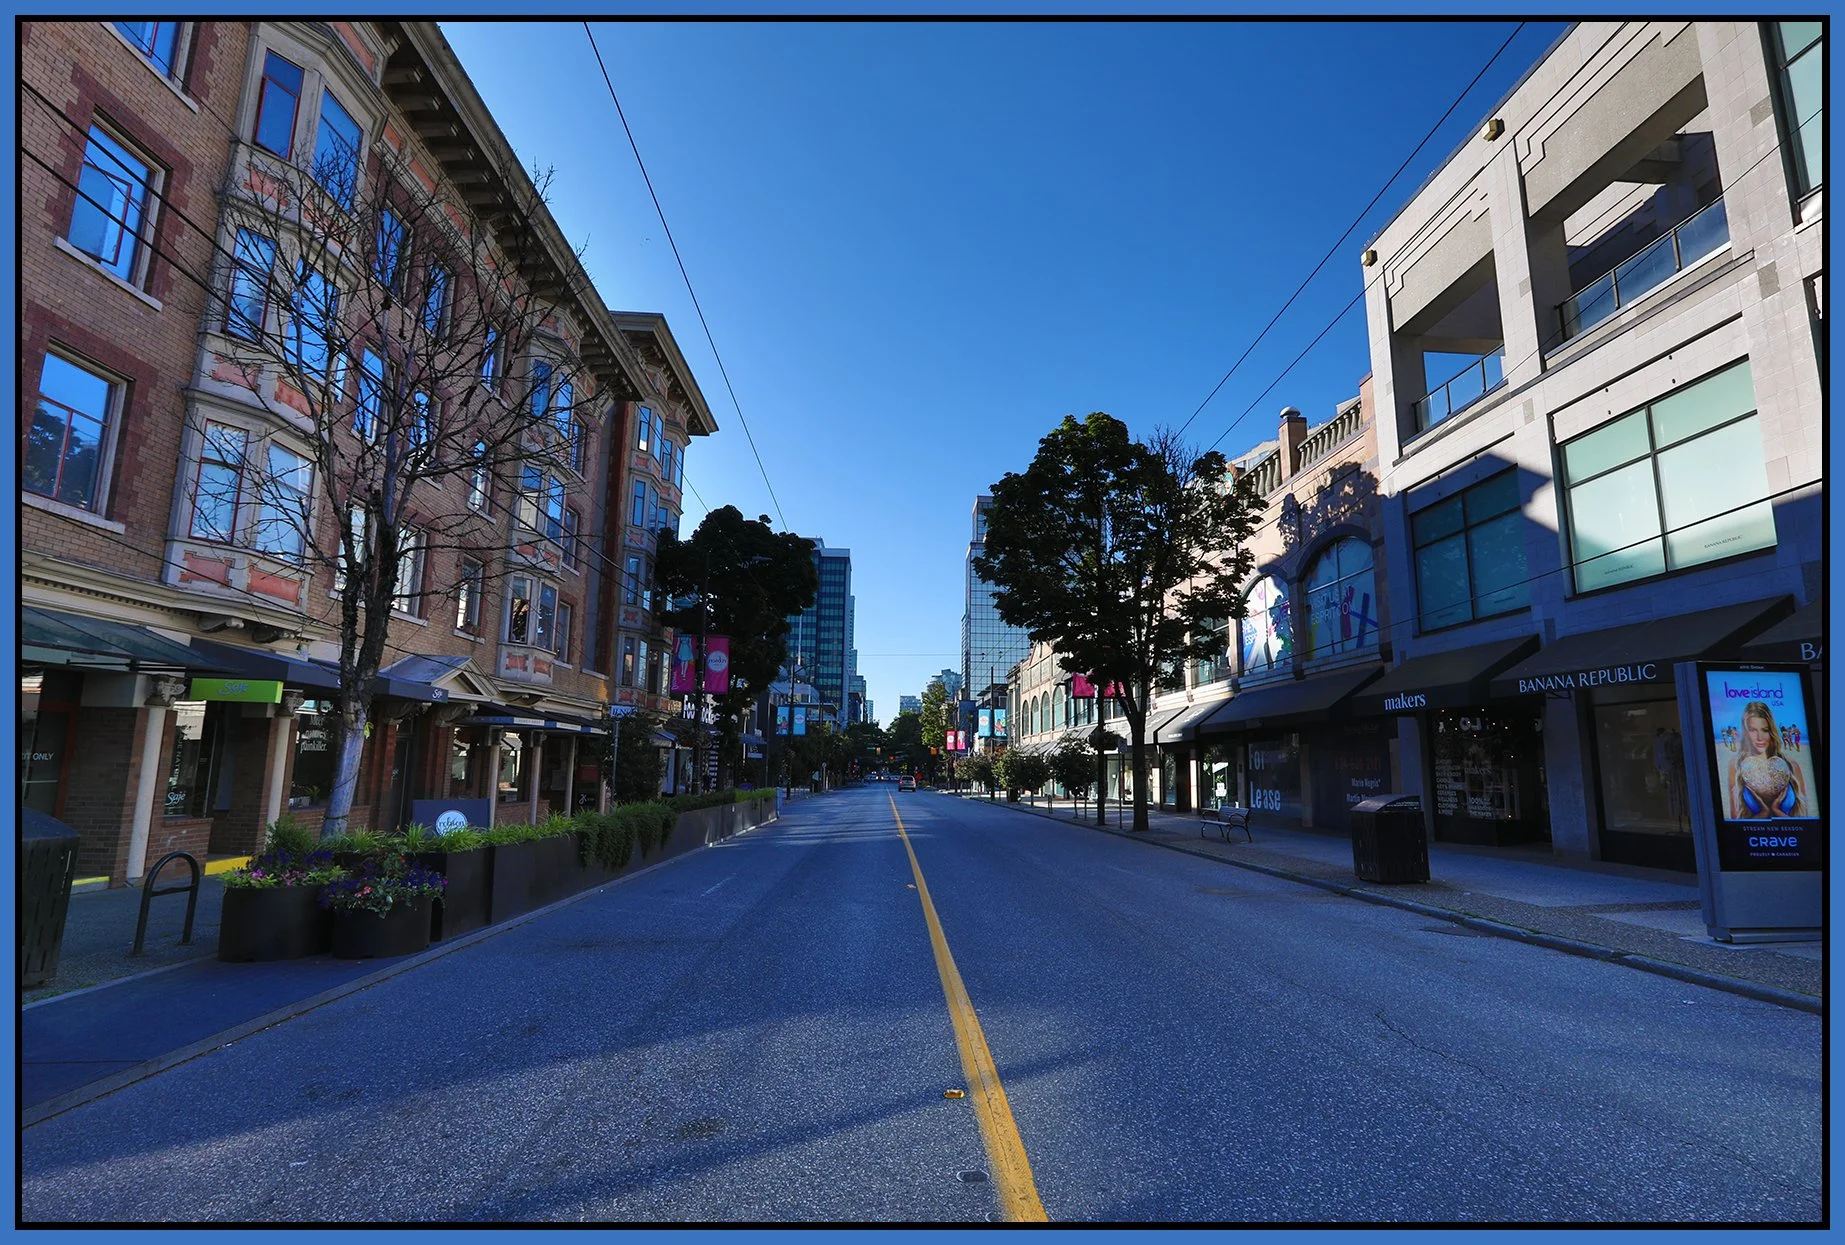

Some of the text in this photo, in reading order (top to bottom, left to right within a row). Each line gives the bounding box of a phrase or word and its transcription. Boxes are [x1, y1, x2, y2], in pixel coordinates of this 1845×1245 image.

[218, 681, 248, 696] Saje
[1518, 663, 1656, 694] BANANA REPUBLIC
[1384, 692, 1428, 712] makers
[32, 752, 55, 761] ONLY
[1248, 743, 1265, 771] For
[164, 791, 187, 806] Saje
[1250, 781, 1282, 811] Lease
